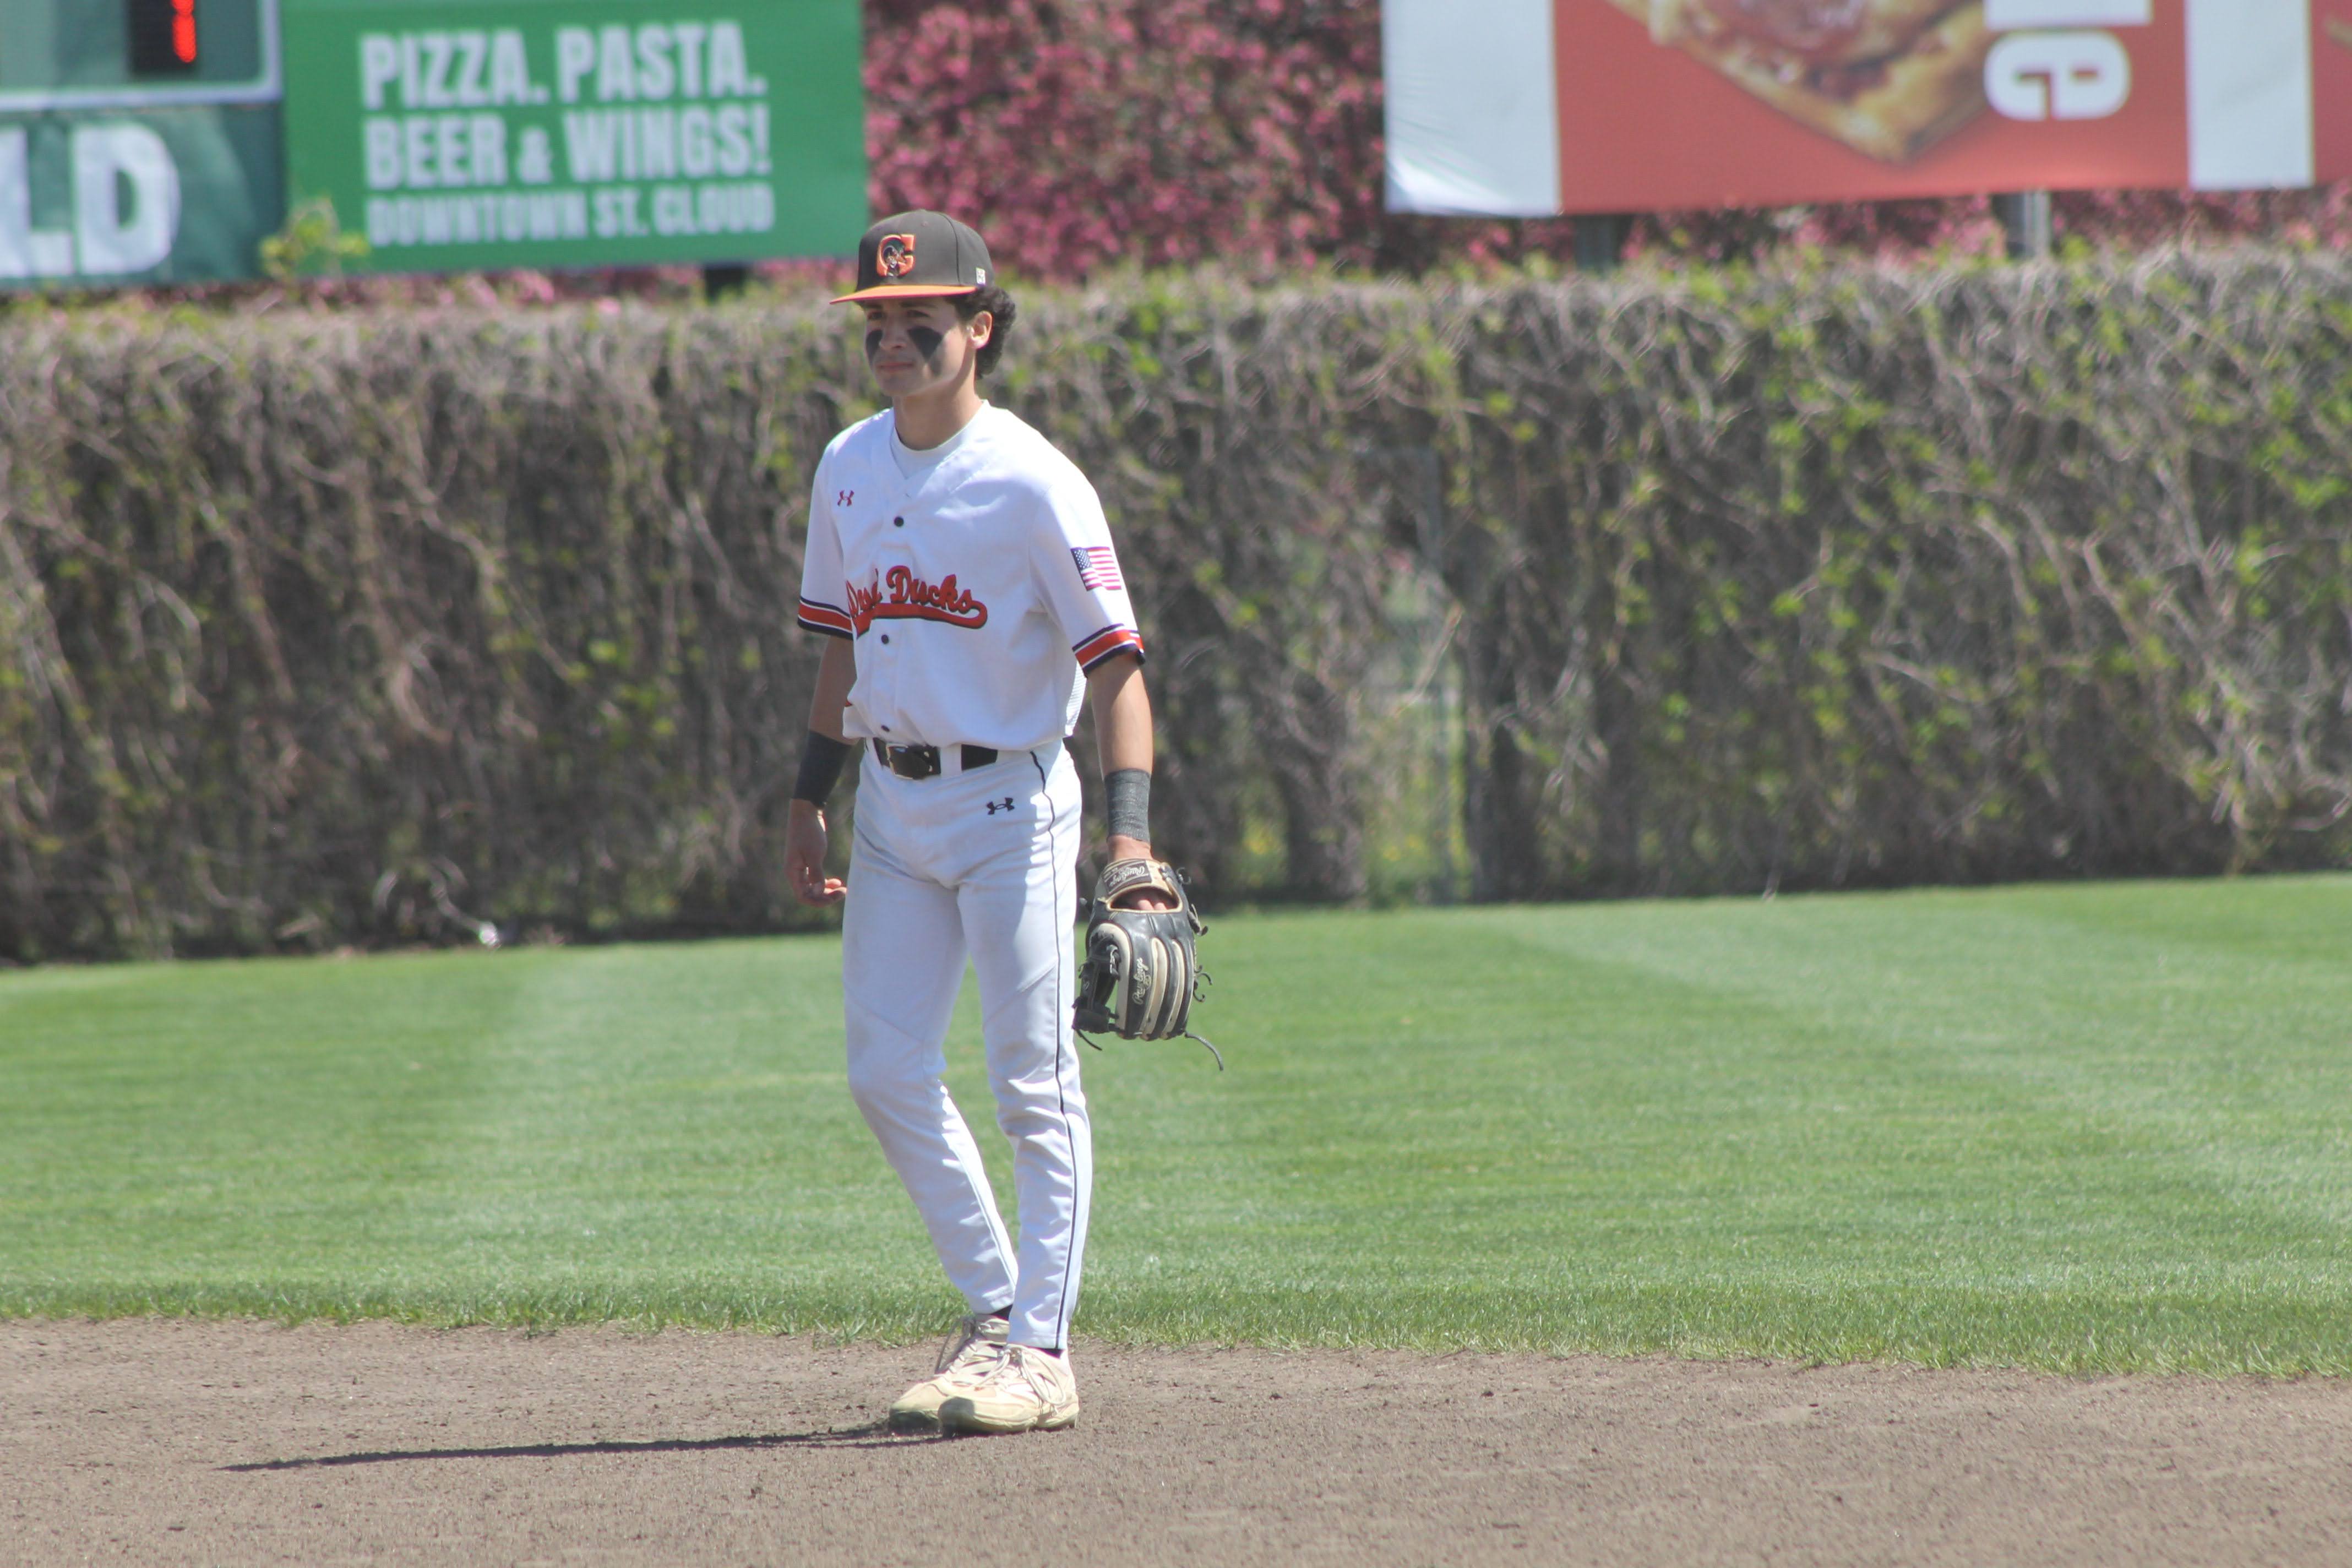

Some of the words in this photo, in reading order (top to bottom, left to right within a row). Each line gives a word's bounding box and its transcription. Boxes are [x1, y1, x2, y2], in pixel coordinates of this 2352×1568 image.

[360, 29, 548, 108] PIZZA.
[557, 20, 768, 102] PASTA.
[363, 116, 508, 188] BEER
[517, 128, 553, 183] &
[563, 104, 771, 181] WINGS!
[367, 190, 587, 247] DOWNTOWN
[594, 187, 649, 237] ST.
[652, 182, 774, 235] CLOUD
[886, 565, 972, 614] Ducks
